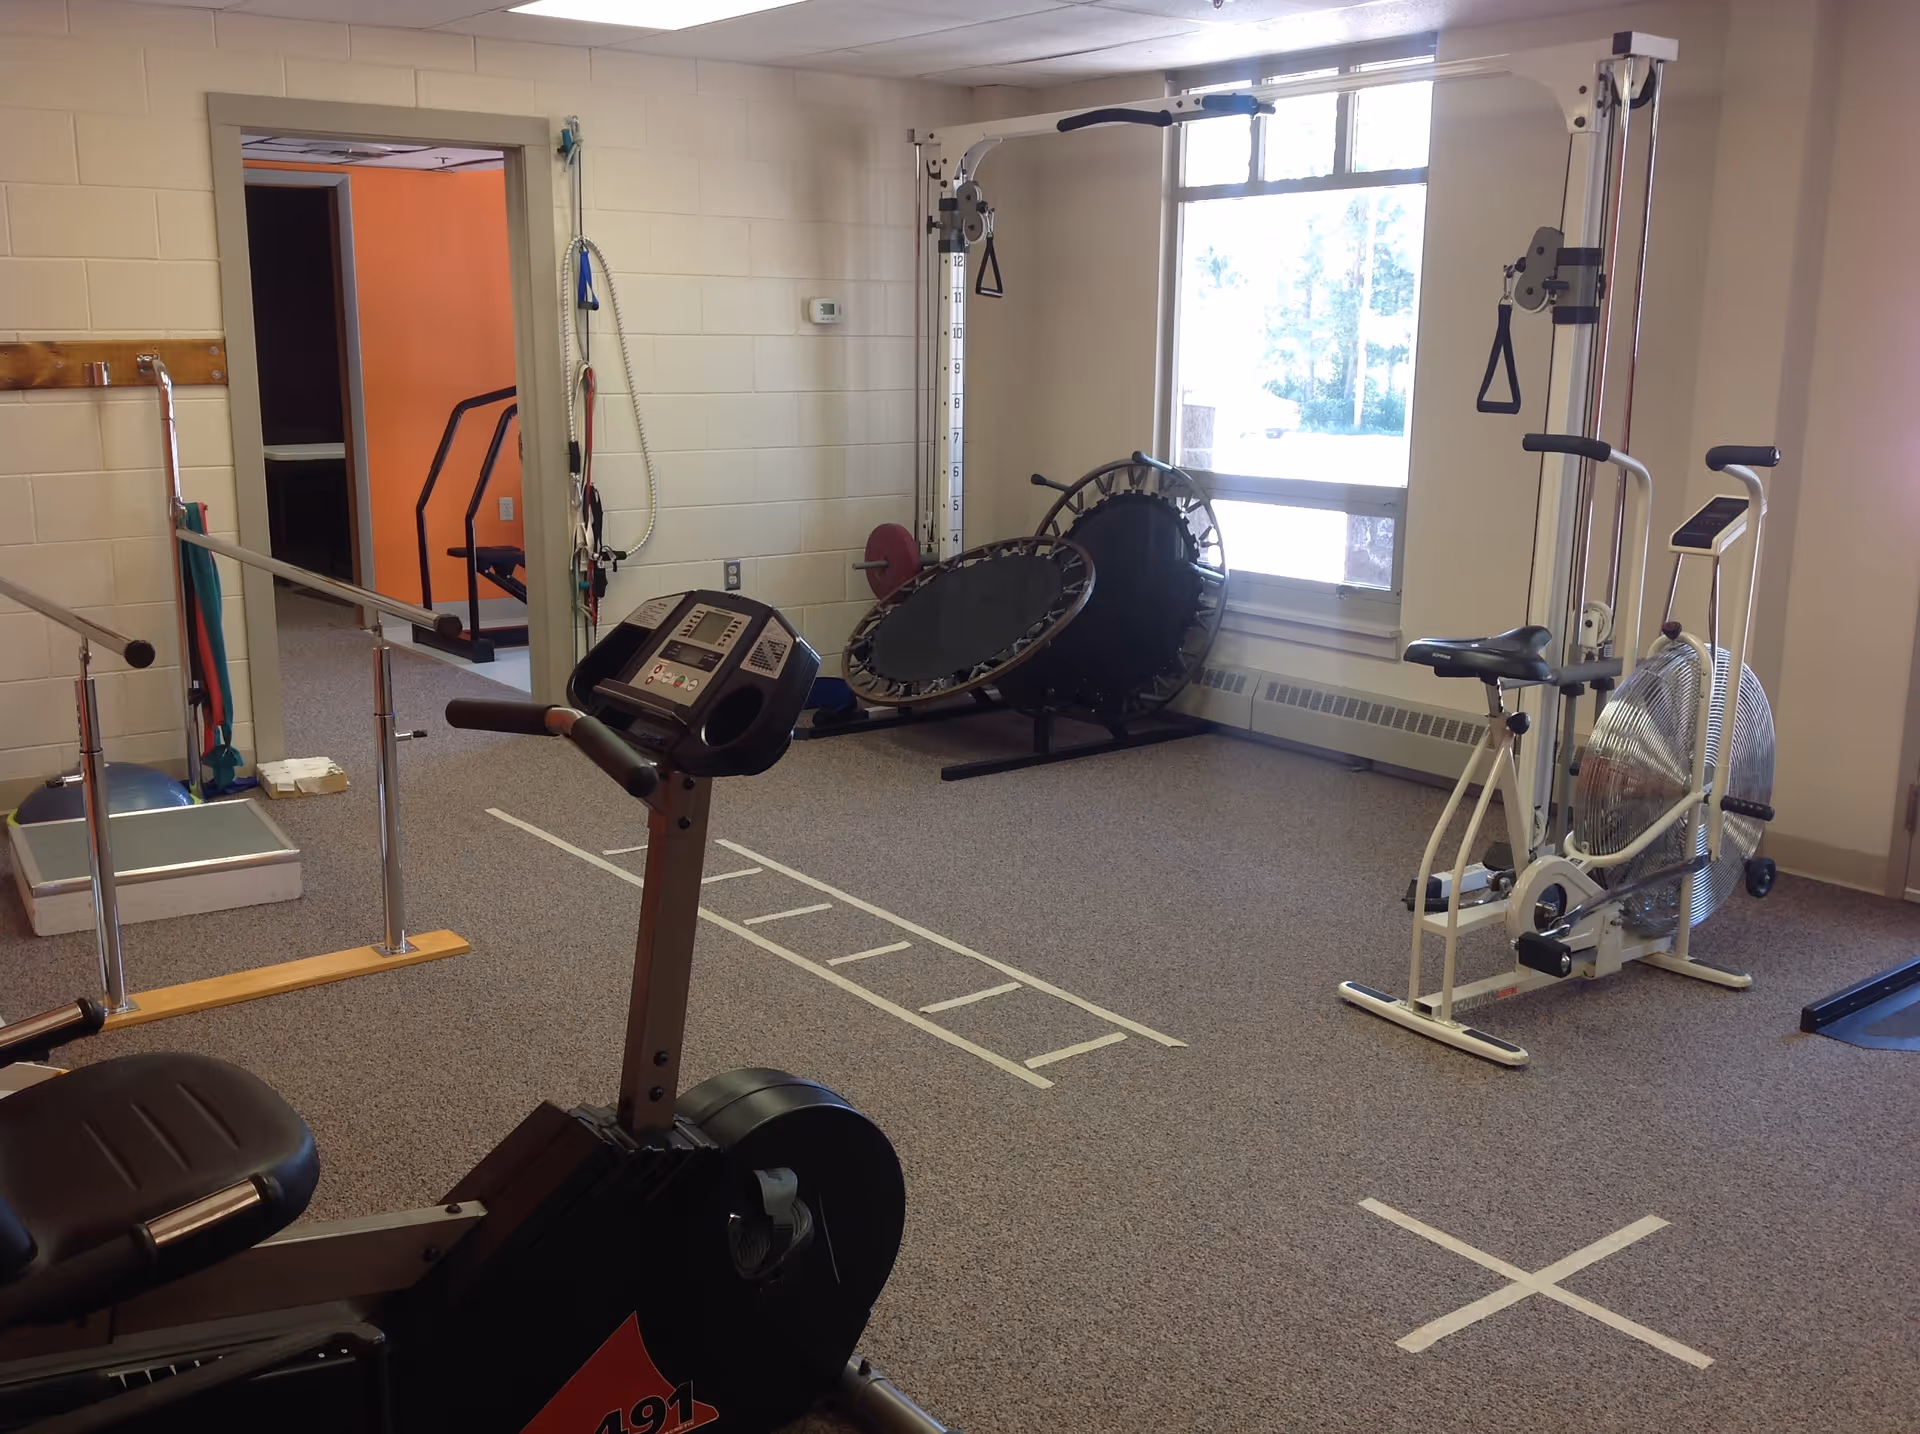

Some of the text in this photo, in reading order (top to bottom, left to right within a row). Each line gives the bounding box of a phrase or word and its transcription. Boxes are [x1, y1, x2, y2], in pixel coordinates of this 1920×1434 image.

[953, 255, 964, 267] 12
[954, 292, 962, 303] 11
[952, 327, 963, 339] 10
[954, 362, 961, 374] 9
[954, 398, 960, 409] 8
[953, 432, 960, 443] 7
[953, 466, 959, 477] 6
[953, 500, 959, 511] 5
[952, 533, 959, 544] 4
[594, 1380, 694, 1434] 491
